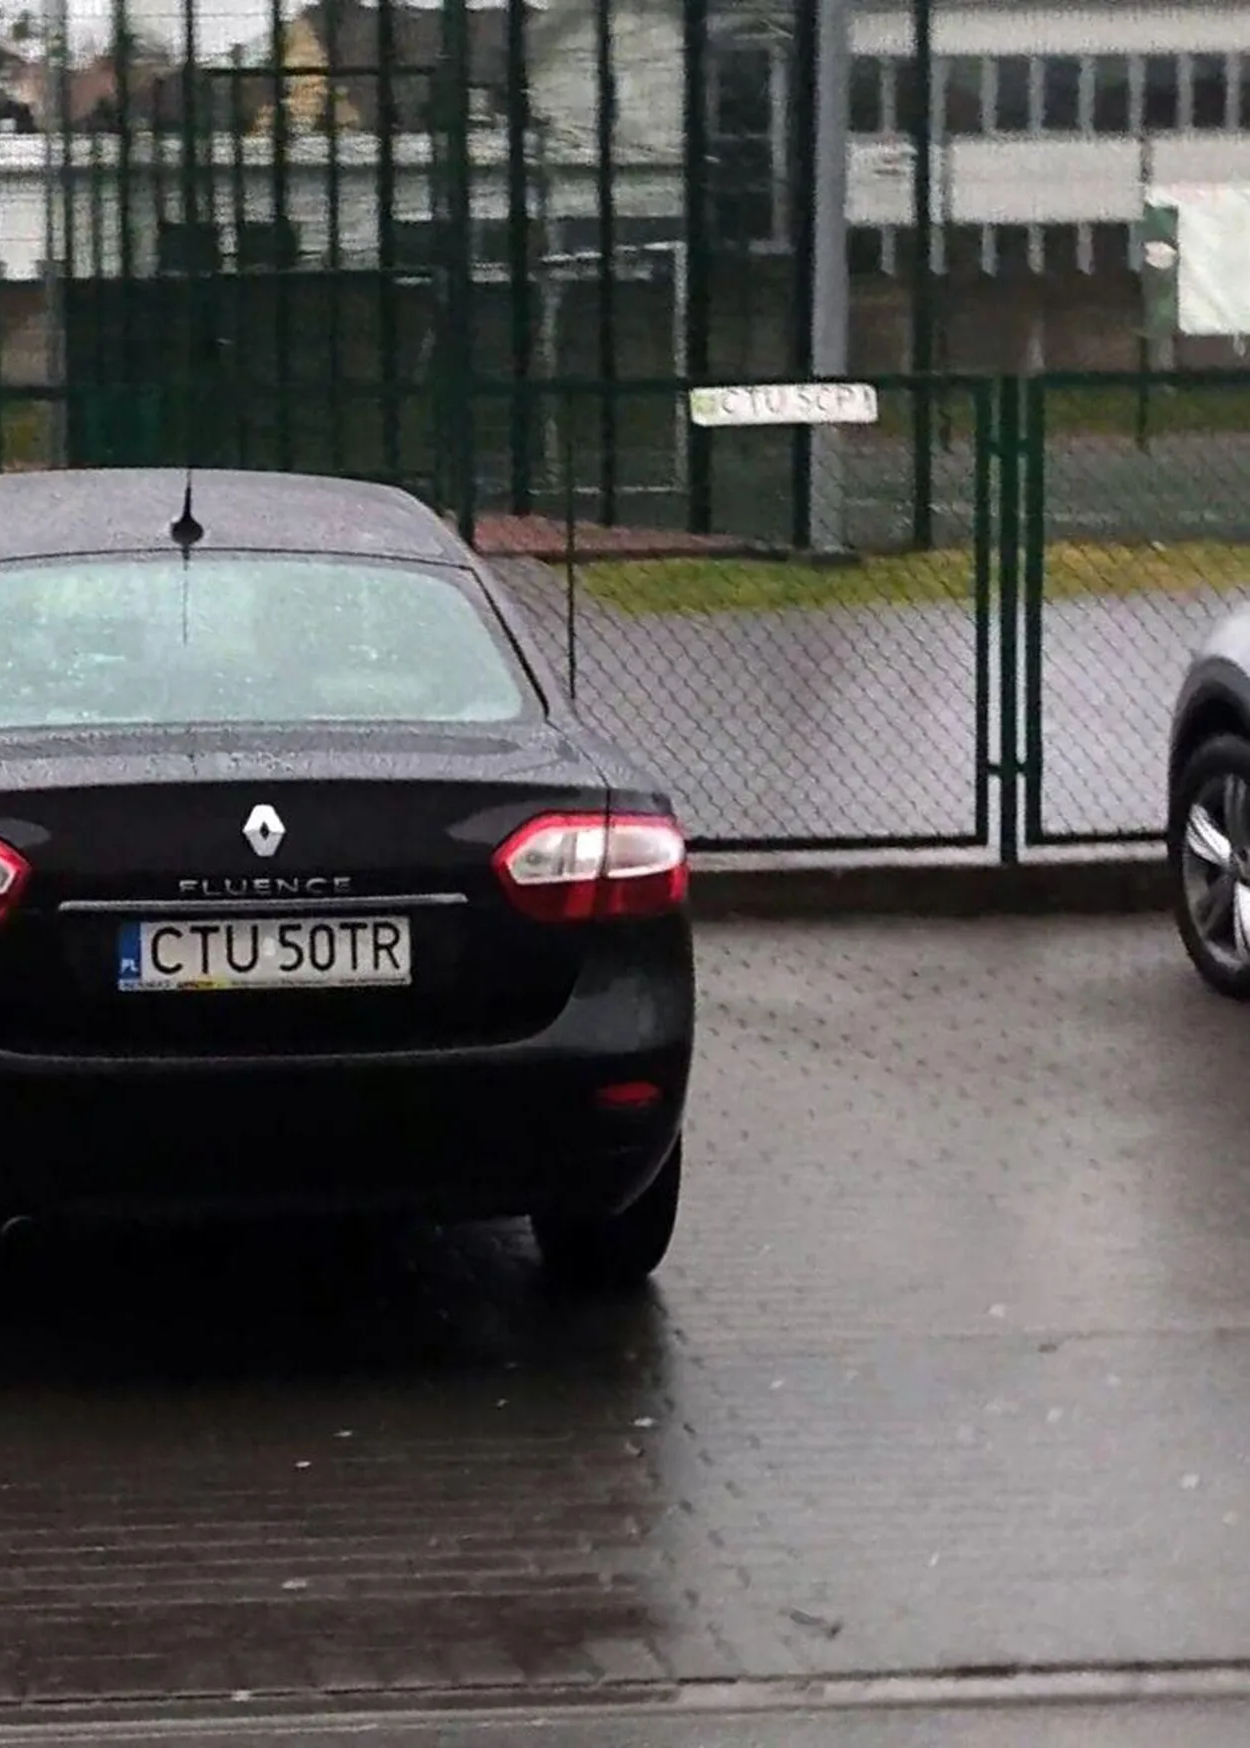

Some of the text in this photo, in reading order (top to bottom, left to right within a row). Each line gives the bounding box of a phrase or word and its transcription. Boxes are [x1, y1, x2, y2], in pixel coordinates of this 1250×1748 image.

[178, 876, 352, 896] FLUENCE
[150, 920, 401, 975] CTU 50TR
